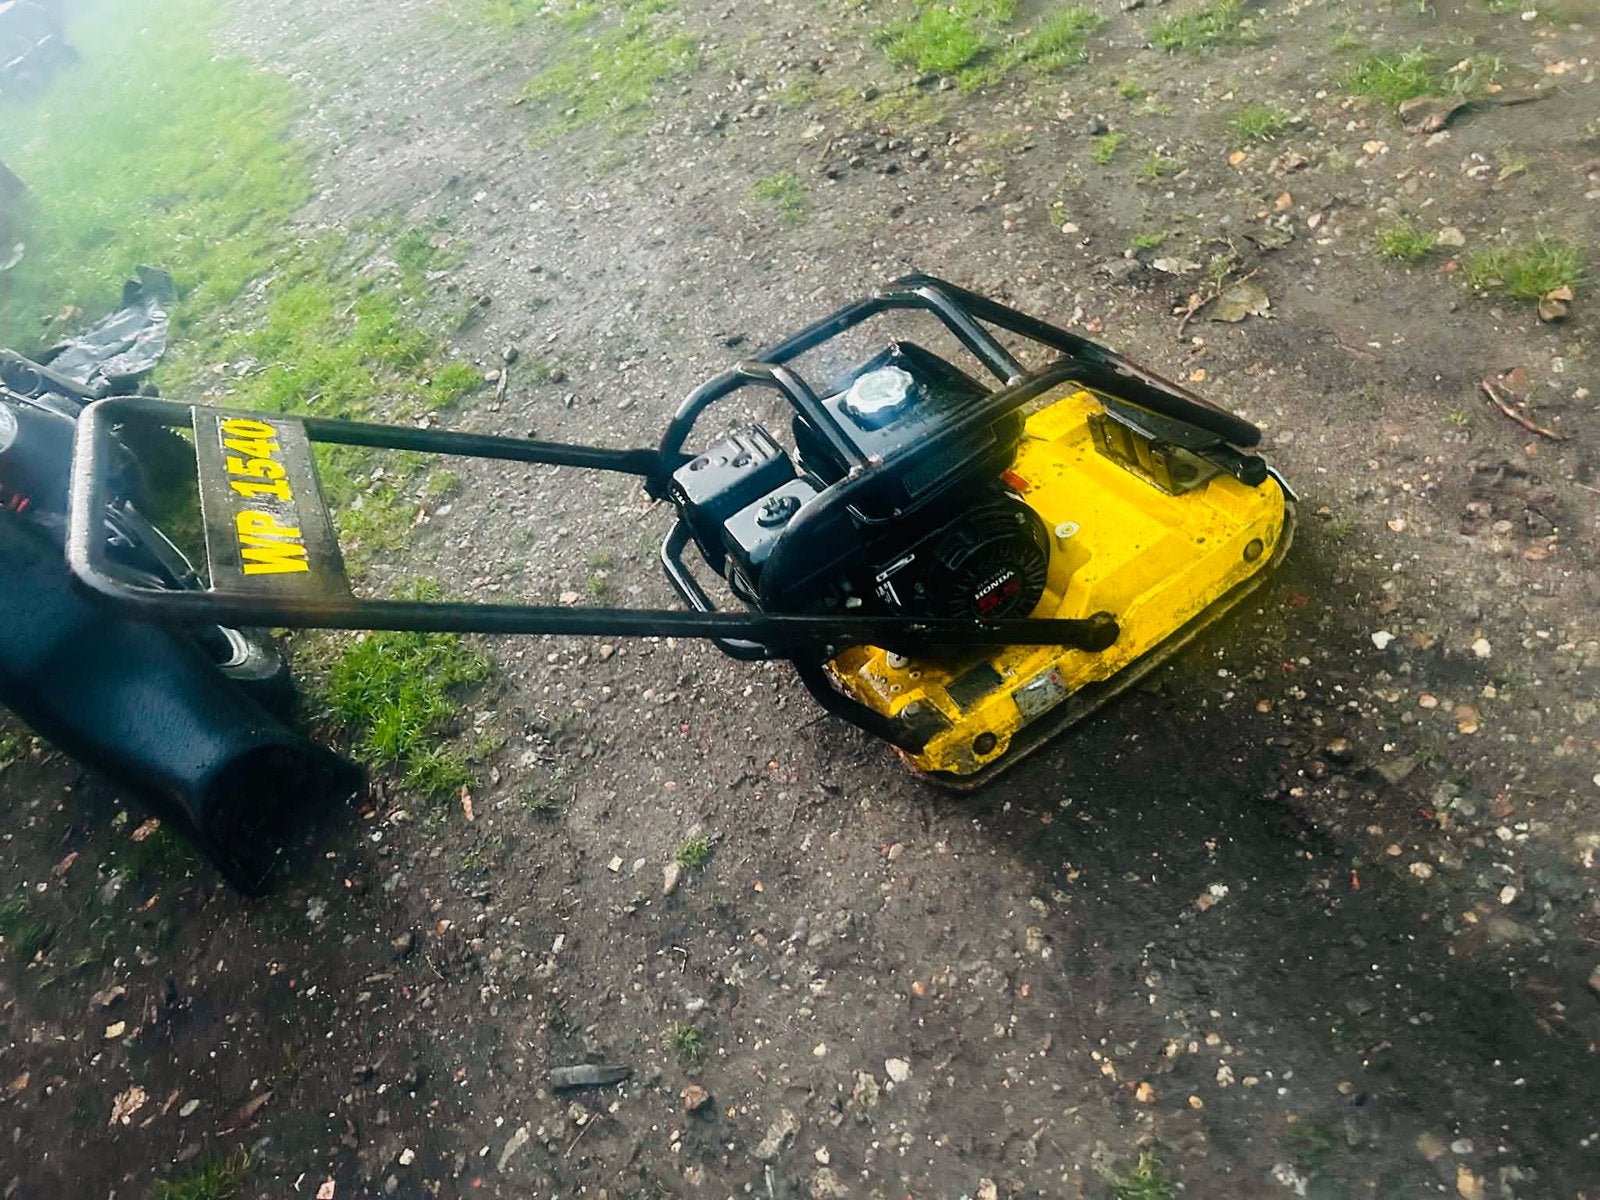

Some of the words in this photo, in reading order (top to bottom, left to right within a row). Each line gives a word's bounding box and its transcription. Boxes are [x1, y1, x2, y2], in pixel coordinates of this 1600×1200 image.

[221, 418, 293, 501] 1540
[236, 510, 309, 575] WP
[974, 570, 1015, 600] HONDA
